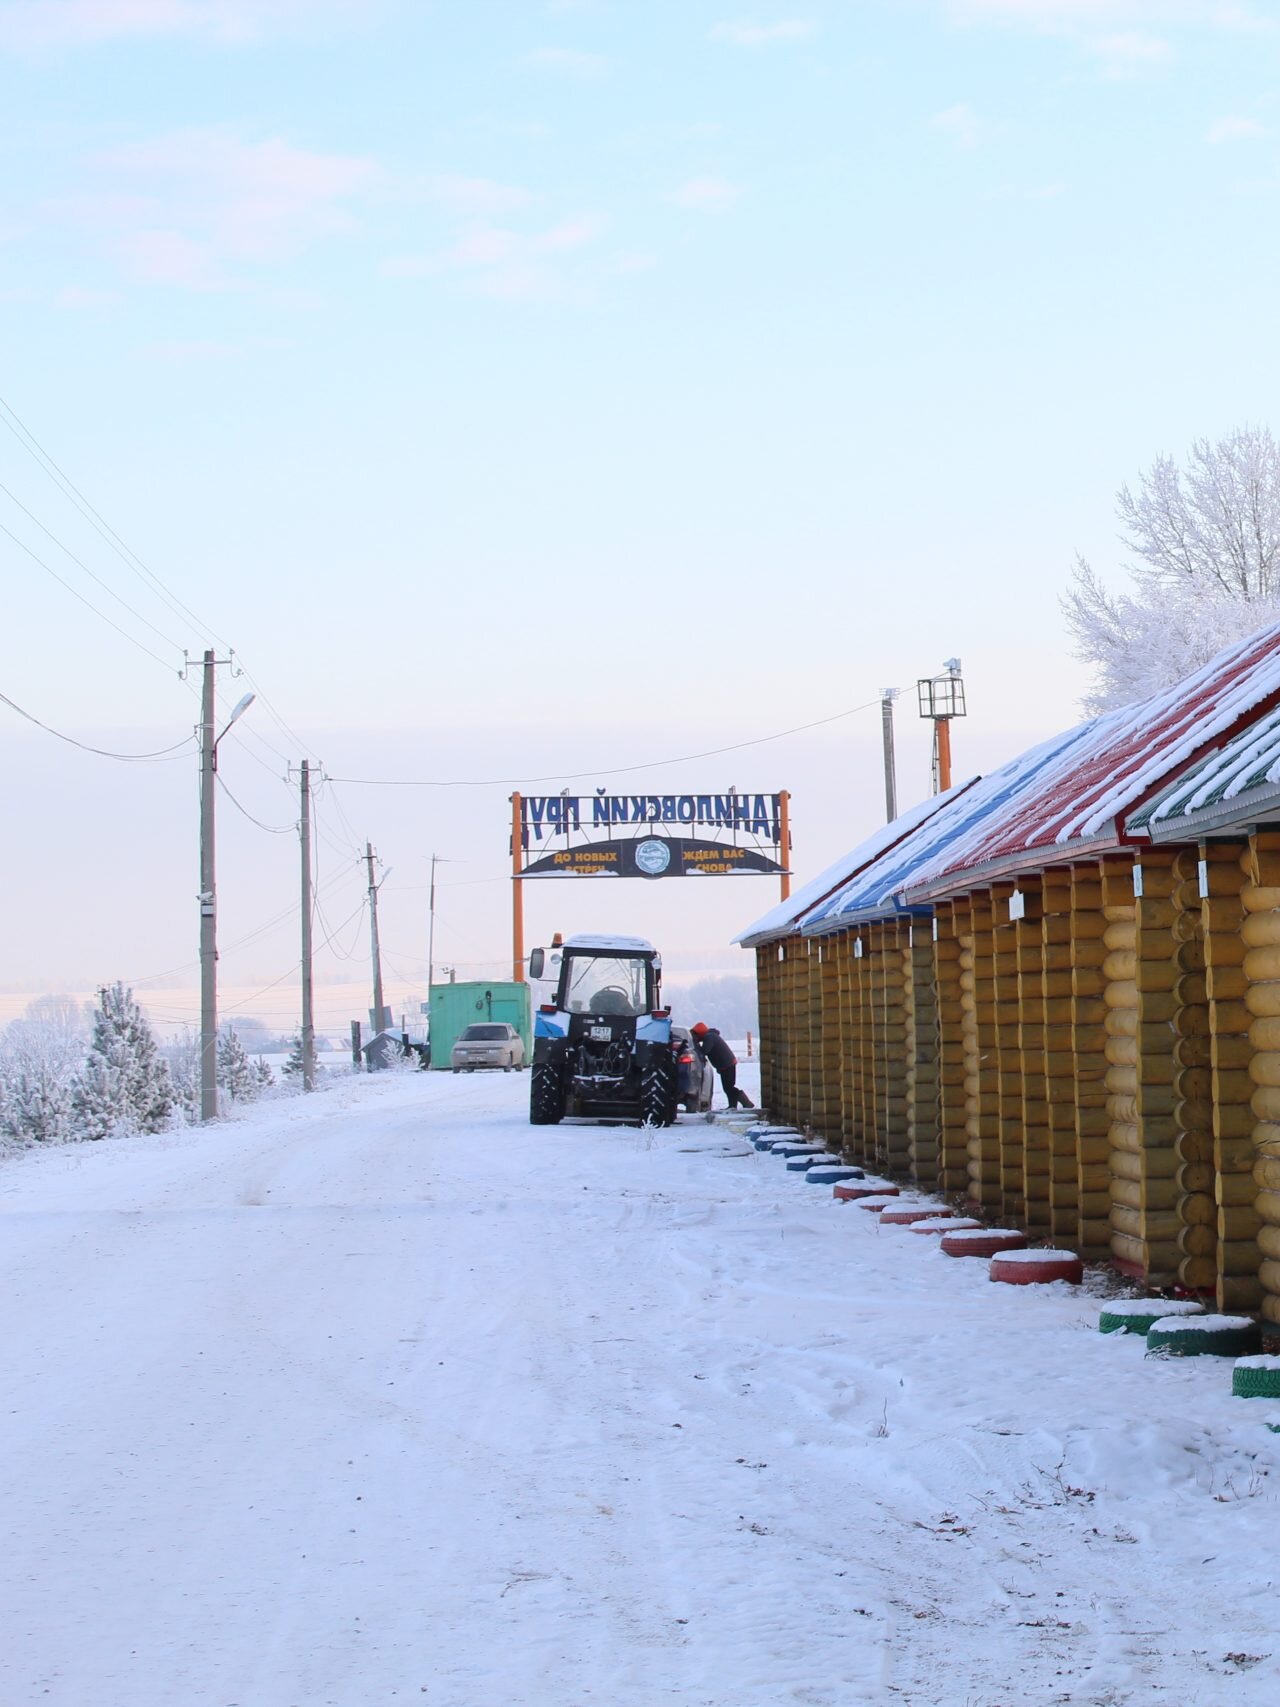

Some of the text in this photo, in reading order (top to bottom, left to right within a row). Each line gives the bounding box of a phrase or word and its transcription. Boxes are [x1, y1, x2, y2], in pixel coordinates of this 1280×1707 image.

[554, 852, 617, 864] ДО НОВЫХ
[683, 849, 745, 861] ЖДЕМ ВАС
[696, 863, 732, 872] СНОВА
